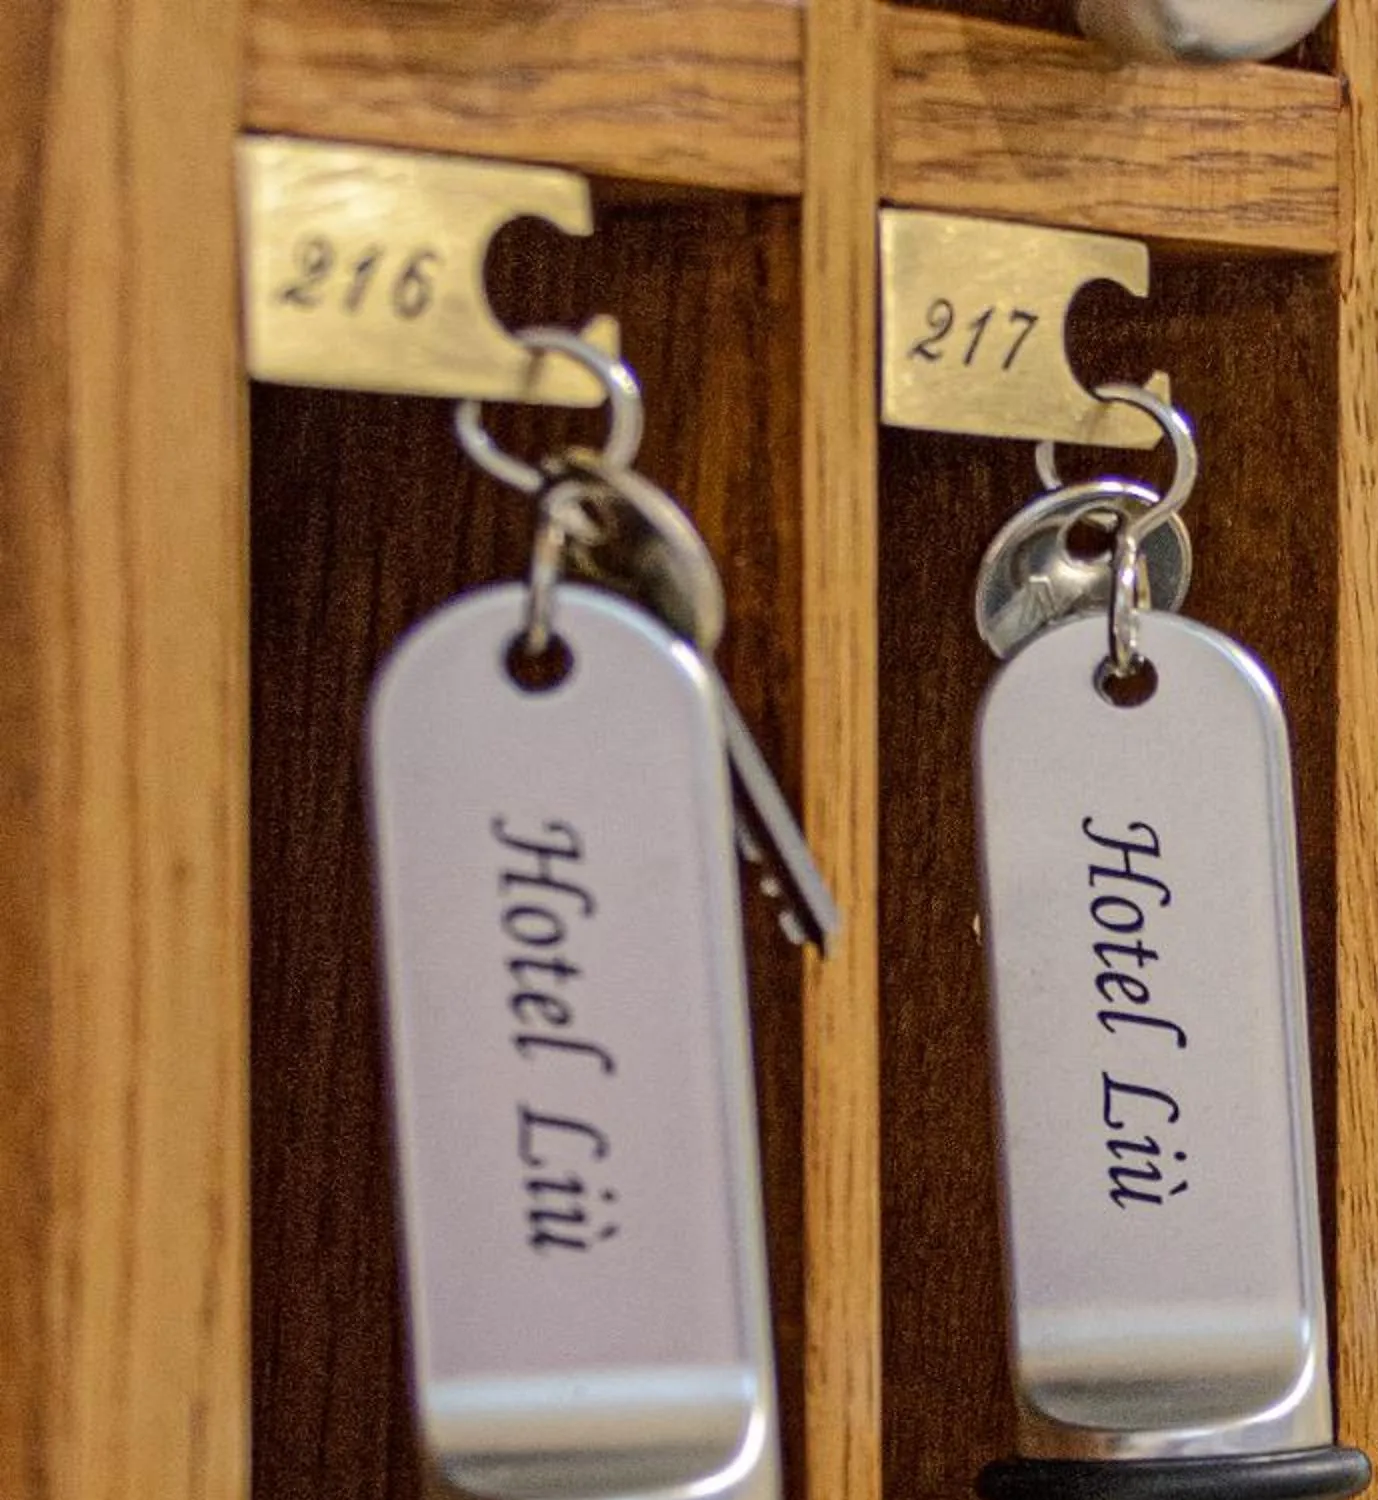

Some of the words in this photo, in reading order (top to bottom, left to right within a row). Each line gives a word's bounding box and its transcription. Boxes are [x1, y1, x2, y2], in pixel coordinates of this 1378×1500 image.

[277, 234, 440, 322] 216
[909, 296, 1040, 372] 217
[490, 815, 618, 1077] Hotel
[1080, 814, 1189, 1051] Hotel
[516, 1103, 621, 1255] Liù
[1100, 1069, 1190, 1210] Liù
